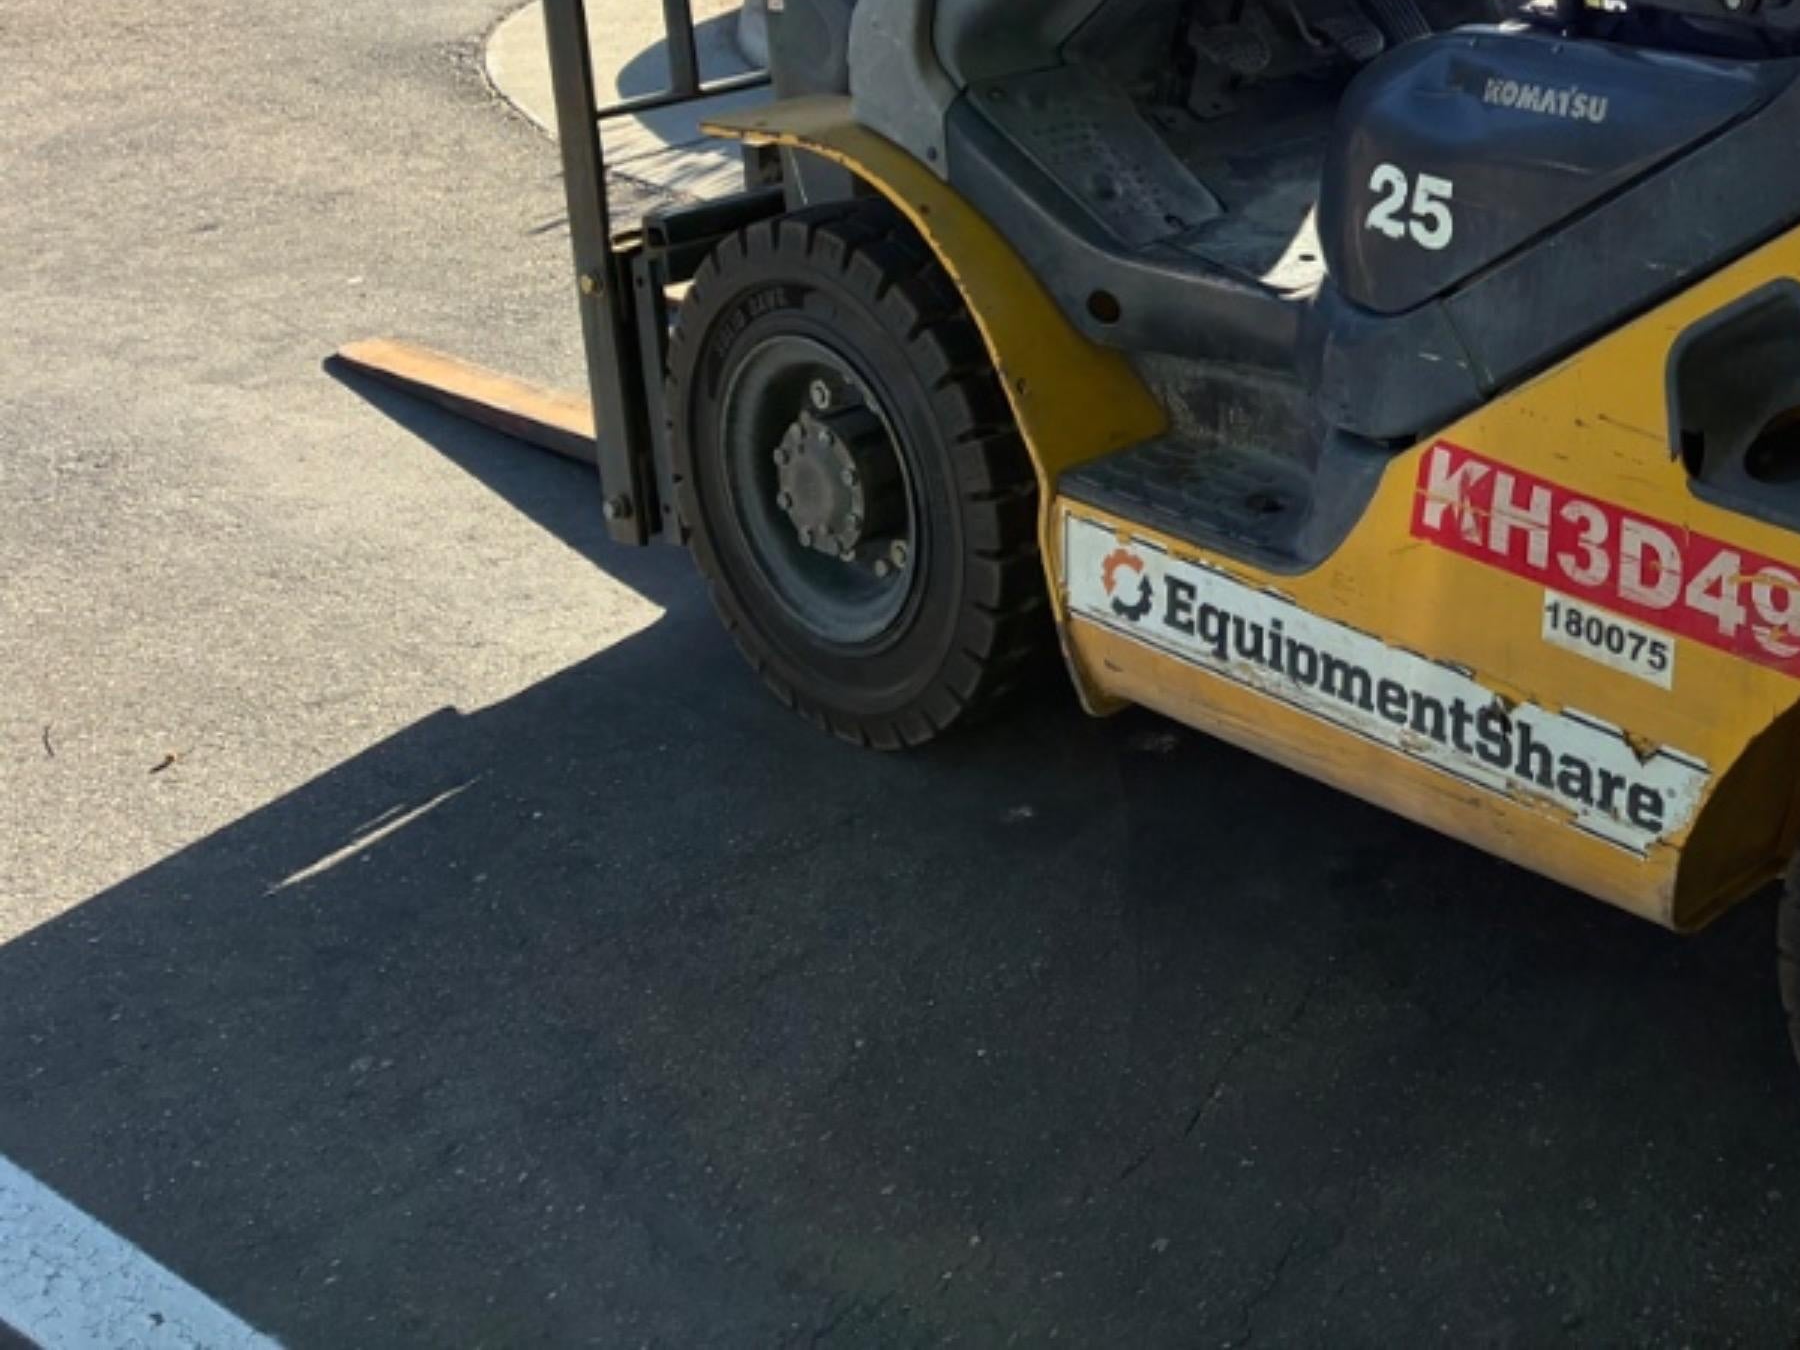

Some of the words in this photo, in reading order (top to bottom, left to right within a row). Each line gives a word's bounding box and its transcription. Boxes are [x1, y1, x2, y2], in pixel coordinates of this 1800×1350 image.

[1484, 77, 1609, 124] KOMATSU
[1364, 163, 1453, 250] 25
[1544, 601, 1668, 672] 180075
[1163, 574, 1664, 834] EquipmentShare
